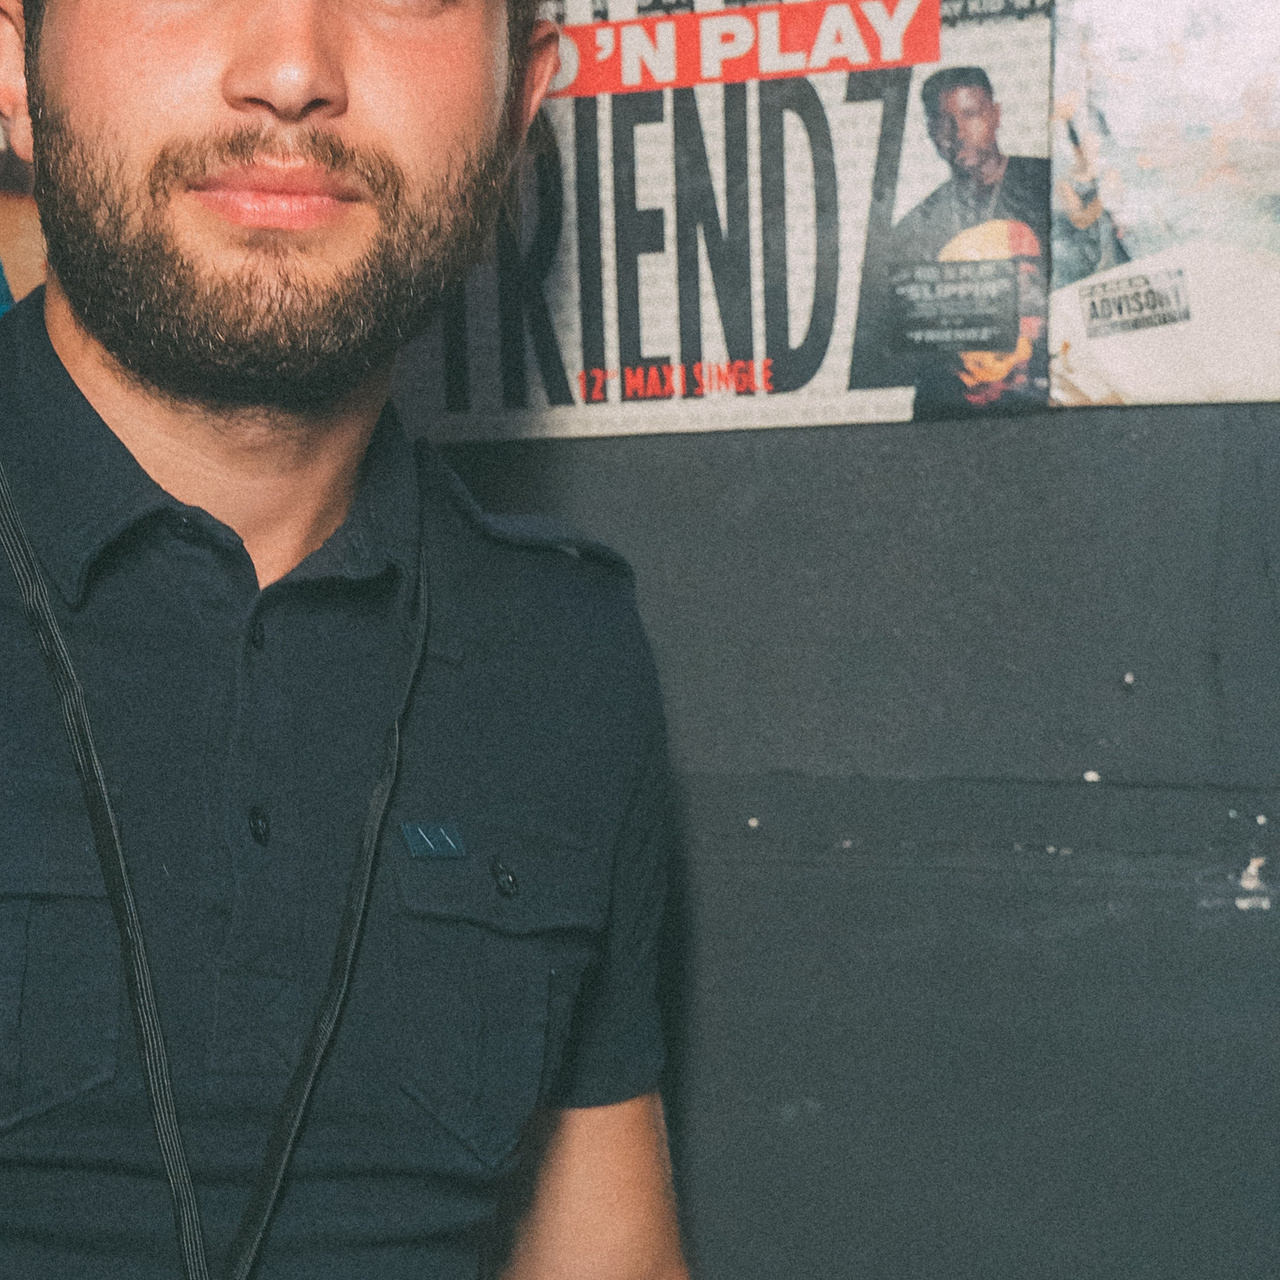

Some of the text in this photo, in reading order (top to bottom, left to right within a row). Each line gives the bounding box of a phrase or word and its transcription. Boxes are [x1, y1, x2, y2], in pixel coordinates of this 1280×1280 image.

[595, 20, 677, 85] 'N
[624, 364, 687, 399] MAXI
[693, 358, 774, 396] SINGLE
